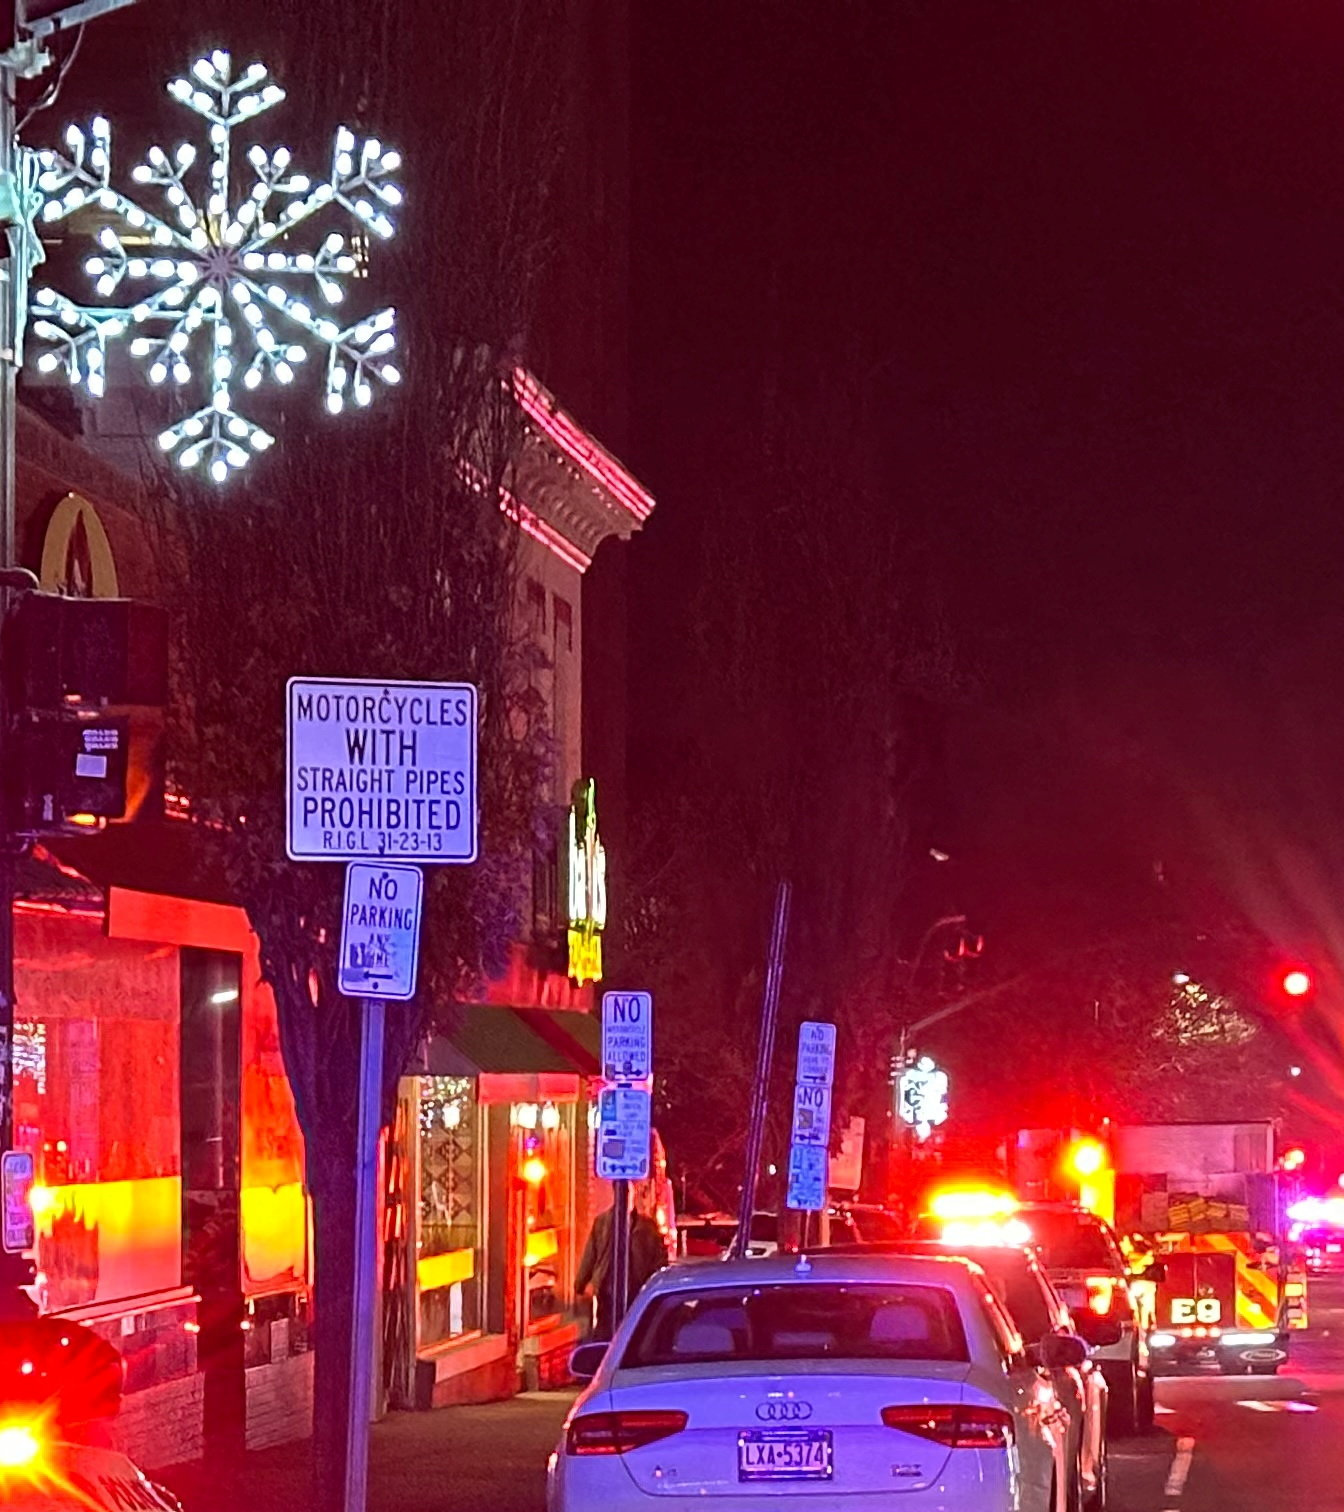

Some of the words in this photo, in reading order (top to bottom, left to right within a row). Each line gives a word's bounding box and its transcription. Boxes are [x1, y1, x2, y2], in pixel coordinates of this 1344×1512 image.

[297, 693, 468, 727] MOTORCYCLES
[346, 728, 417, 766] WITH
[297, 766, 395, 793] STRAIGHT
[406, 770, 465, 795] PIPES
[304, 797, 461, 830] PROHIBITED
[378, 832, 443, 852] 31-23-13
[369, 877, 398, 900] NO
[350, 903, 413, 930] PARKING
[614, 997, 640, 1023] NO
[607, 1037, 646, 1048] PARKING
[810, 1028, 824, 1041] NO
[607, 1051, 646, 1062] ALLOWED
[803, 1088, 824, 1107] NO
